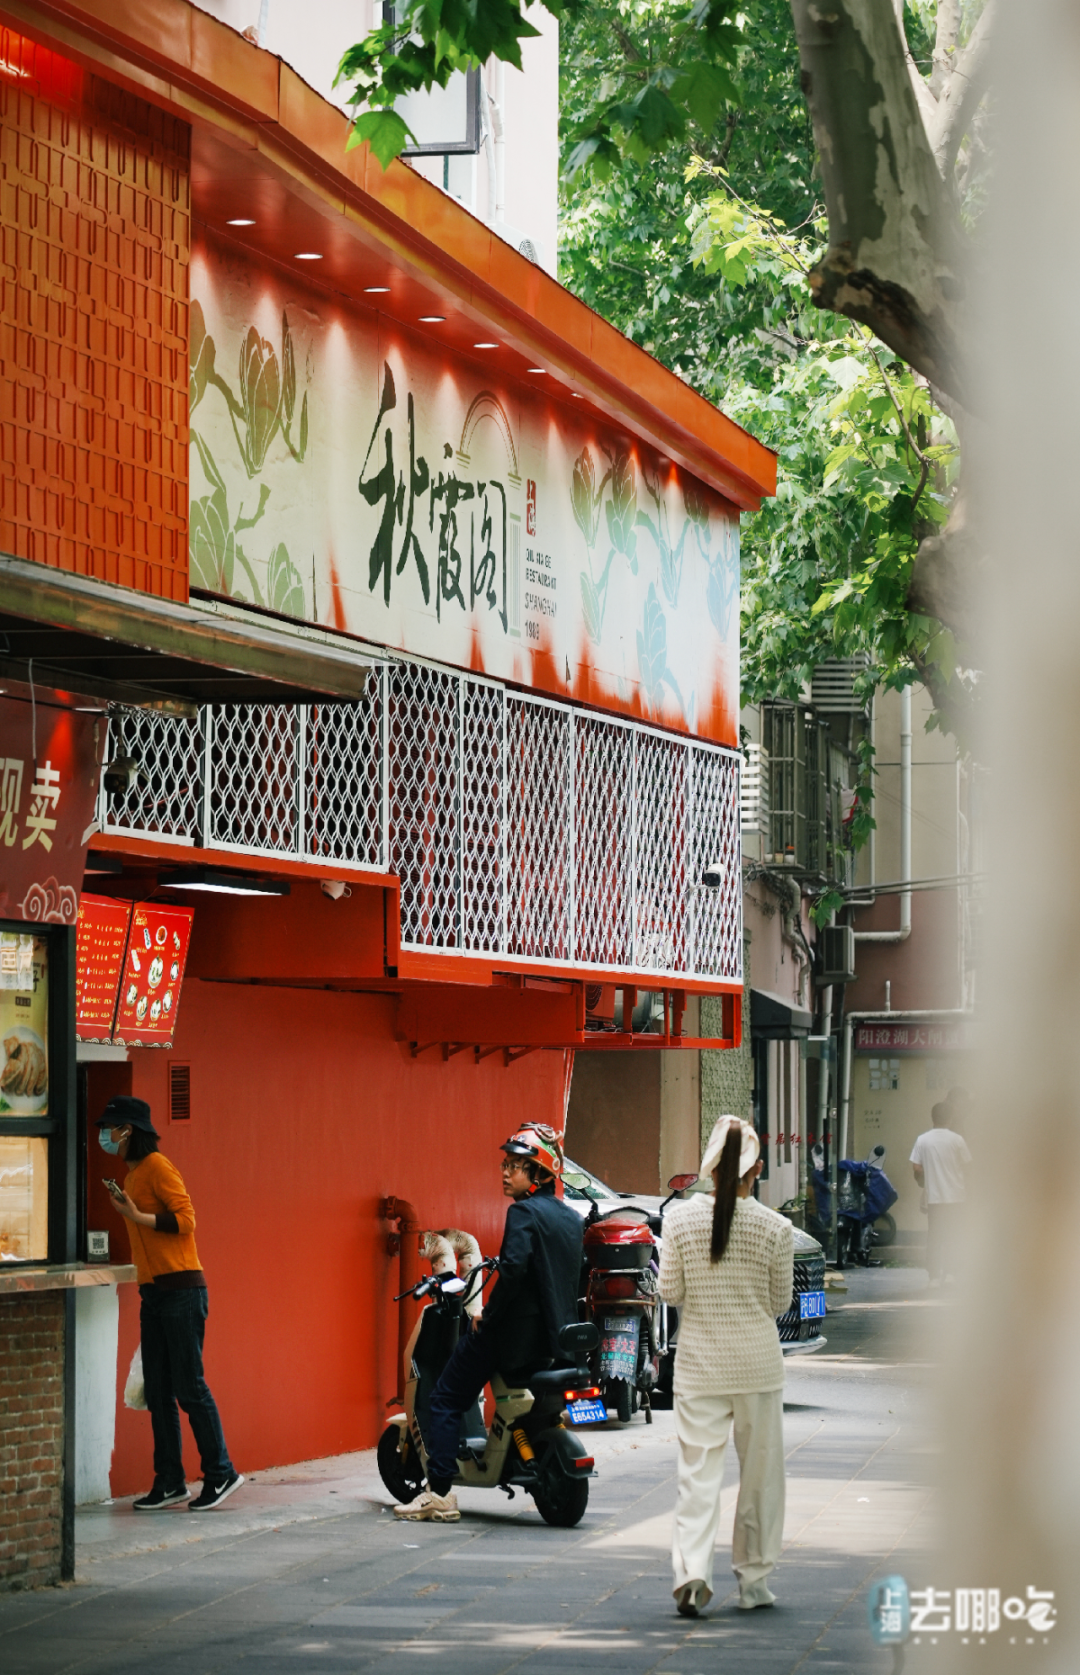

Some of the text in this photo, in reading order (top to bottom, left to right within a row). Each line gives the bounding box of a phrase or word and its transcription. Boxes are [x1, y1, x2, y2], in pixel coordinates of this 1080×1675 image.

[359, 359, 508, 634] 秋霞阁
[525, 591, 557, 617] SHANGHAI
